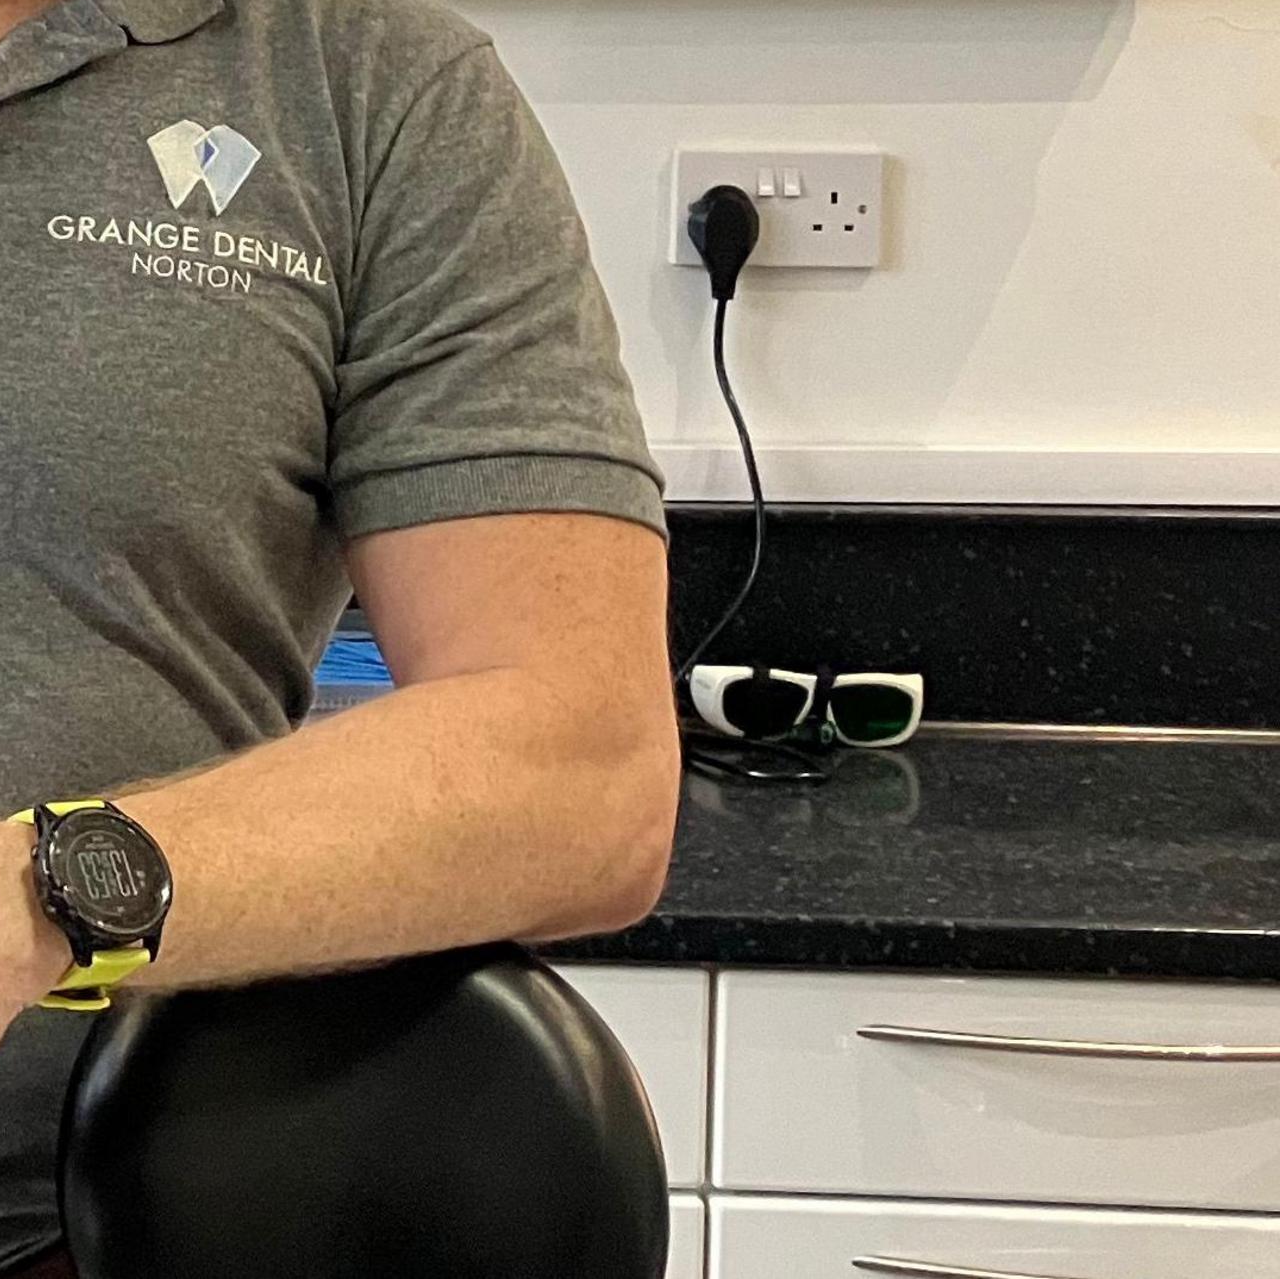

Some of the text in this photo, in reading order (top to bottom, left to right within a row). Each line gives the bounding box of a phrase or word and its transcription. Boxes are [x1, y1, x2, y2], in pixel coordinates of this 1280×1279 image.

[46, 215, 328, 286] GRANGE DENTAL
[131, 251, 252, 294] NORTON
